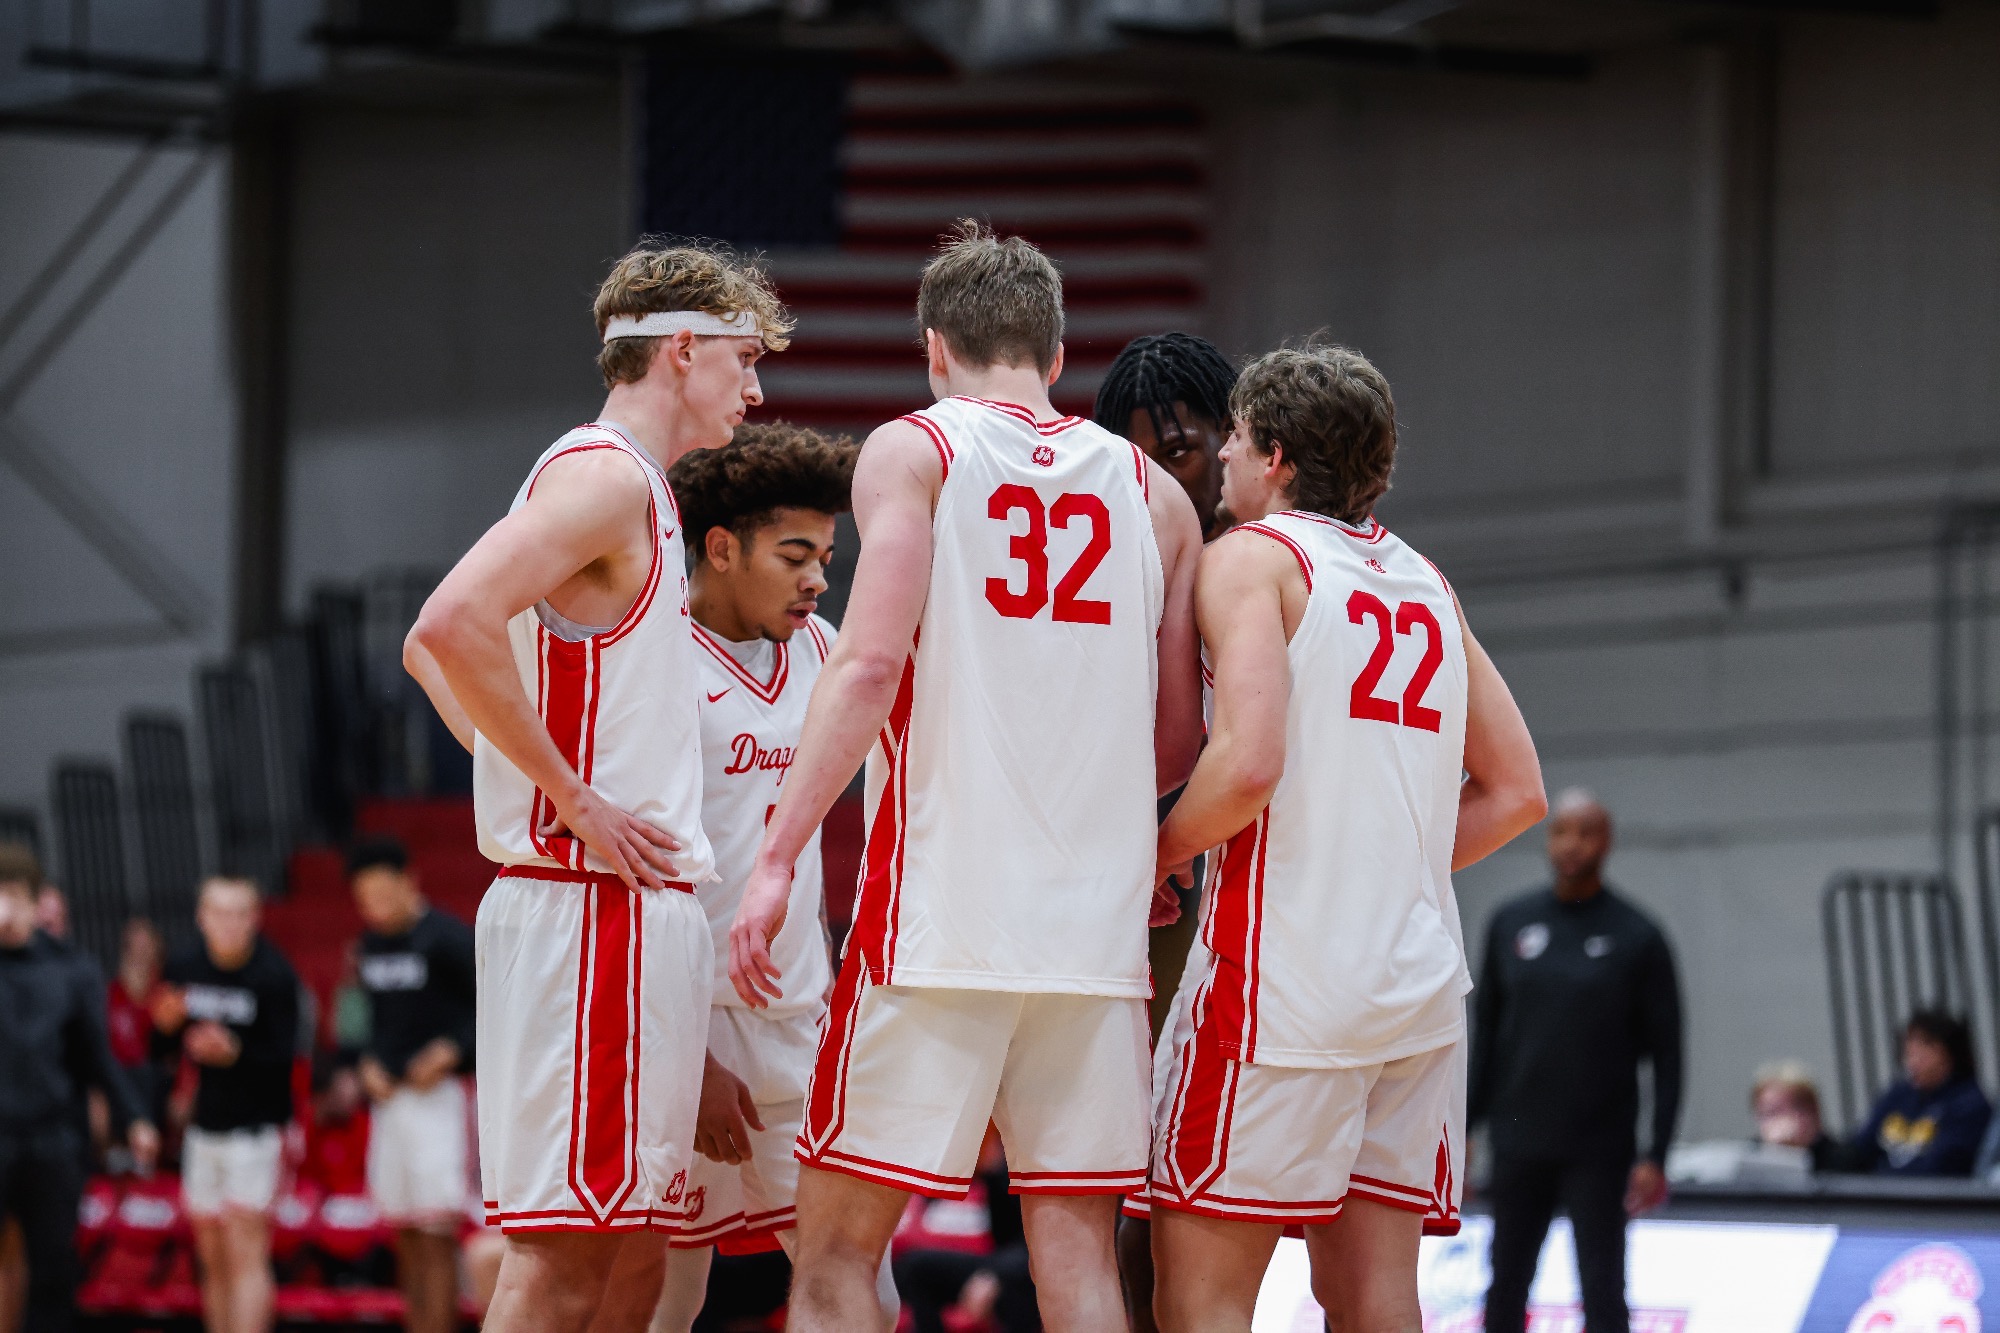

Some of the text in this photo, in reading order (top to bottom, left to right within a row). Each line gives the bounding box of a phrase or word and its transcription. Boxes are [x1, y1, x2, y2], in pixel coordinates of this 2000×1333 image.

[985, 483, 1111, 625] 32
[1346, 590, 1444, 734] 22
[724, 733, 798, 787] Drag
